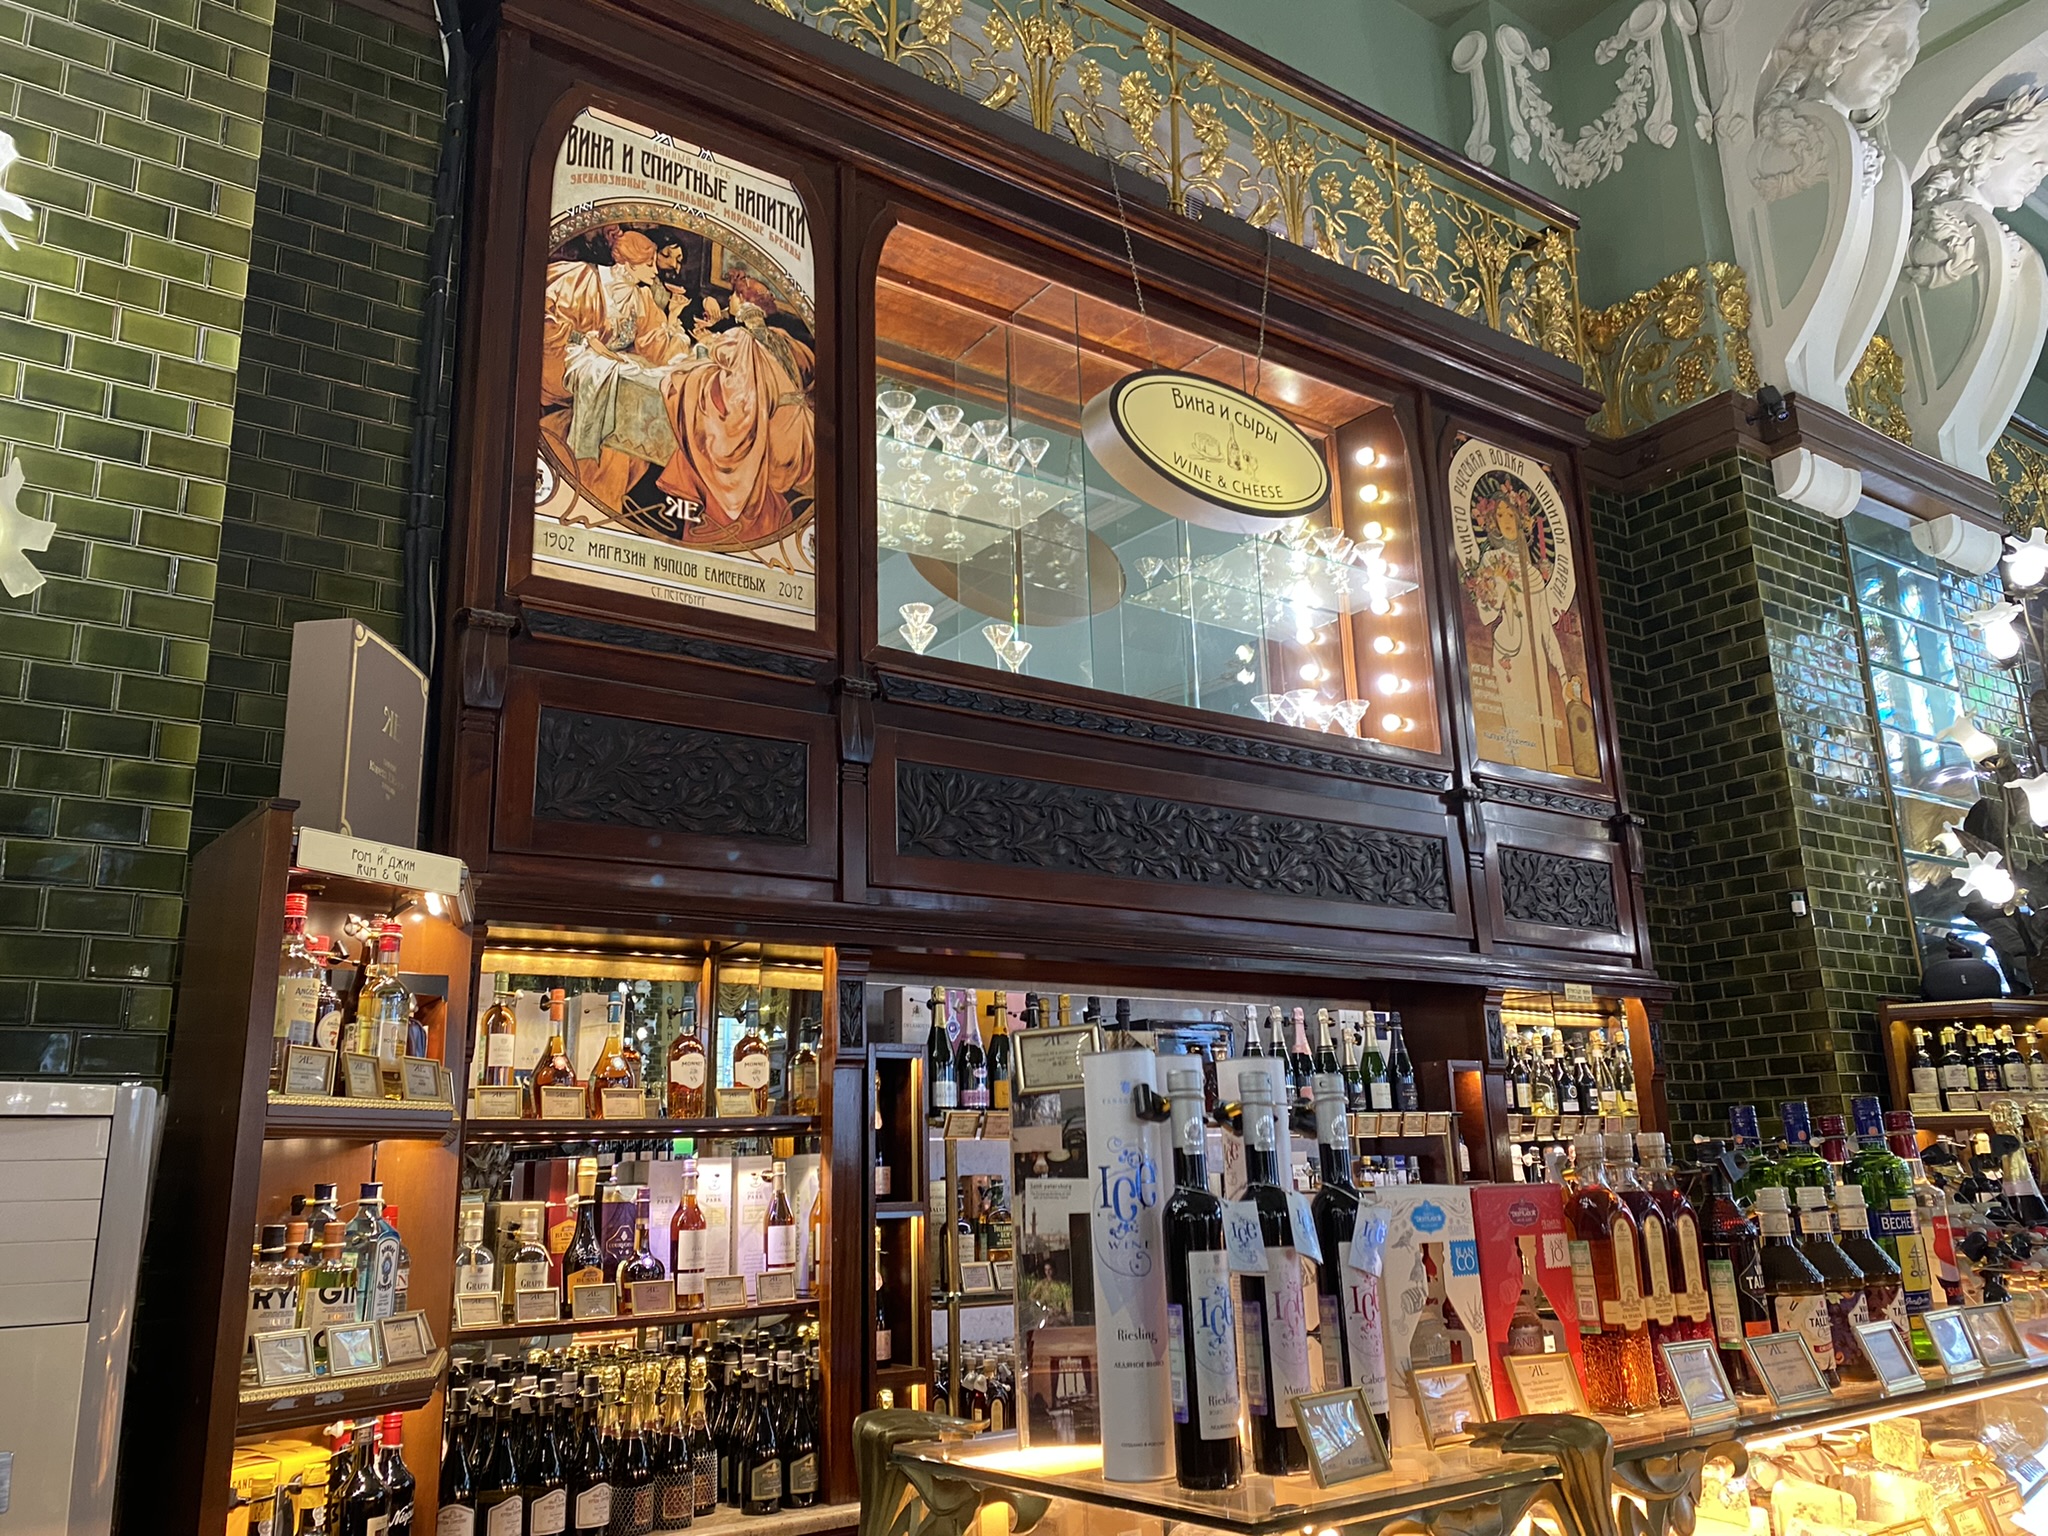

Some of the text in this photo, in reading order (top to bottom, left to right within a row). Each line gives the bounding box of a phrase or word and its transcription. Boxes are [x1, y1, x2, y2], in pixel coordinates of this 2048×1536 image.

[566, 125, 806, 248] ВИНА И СПИРТНЫЕ НАПИТКИ
[1171, 387, 1278, 444] Вина и сыры
[1173, 452, 1284, 499] WINE & CHEESE
[1489, 447, 1525, 476] ВОДКА
[1535, 481, 1568, 546] НАПИТОК
[543, 531, 804, 600] 1902 МАГАЗИН КУПЦОВ ЕЛИСЕЕВЫХ 2012
[664, 588, 707, 606] ПЕТЕРБУРГ
[352, 848, 416, 872] РОМ И ДЖИН
[356, 863, 409, 884] RUM & GIN
[1117, 1328, 1158, 1344] Riesling
[1114, 1360, 1144, 1369] ЛЕДЯНОЕ
